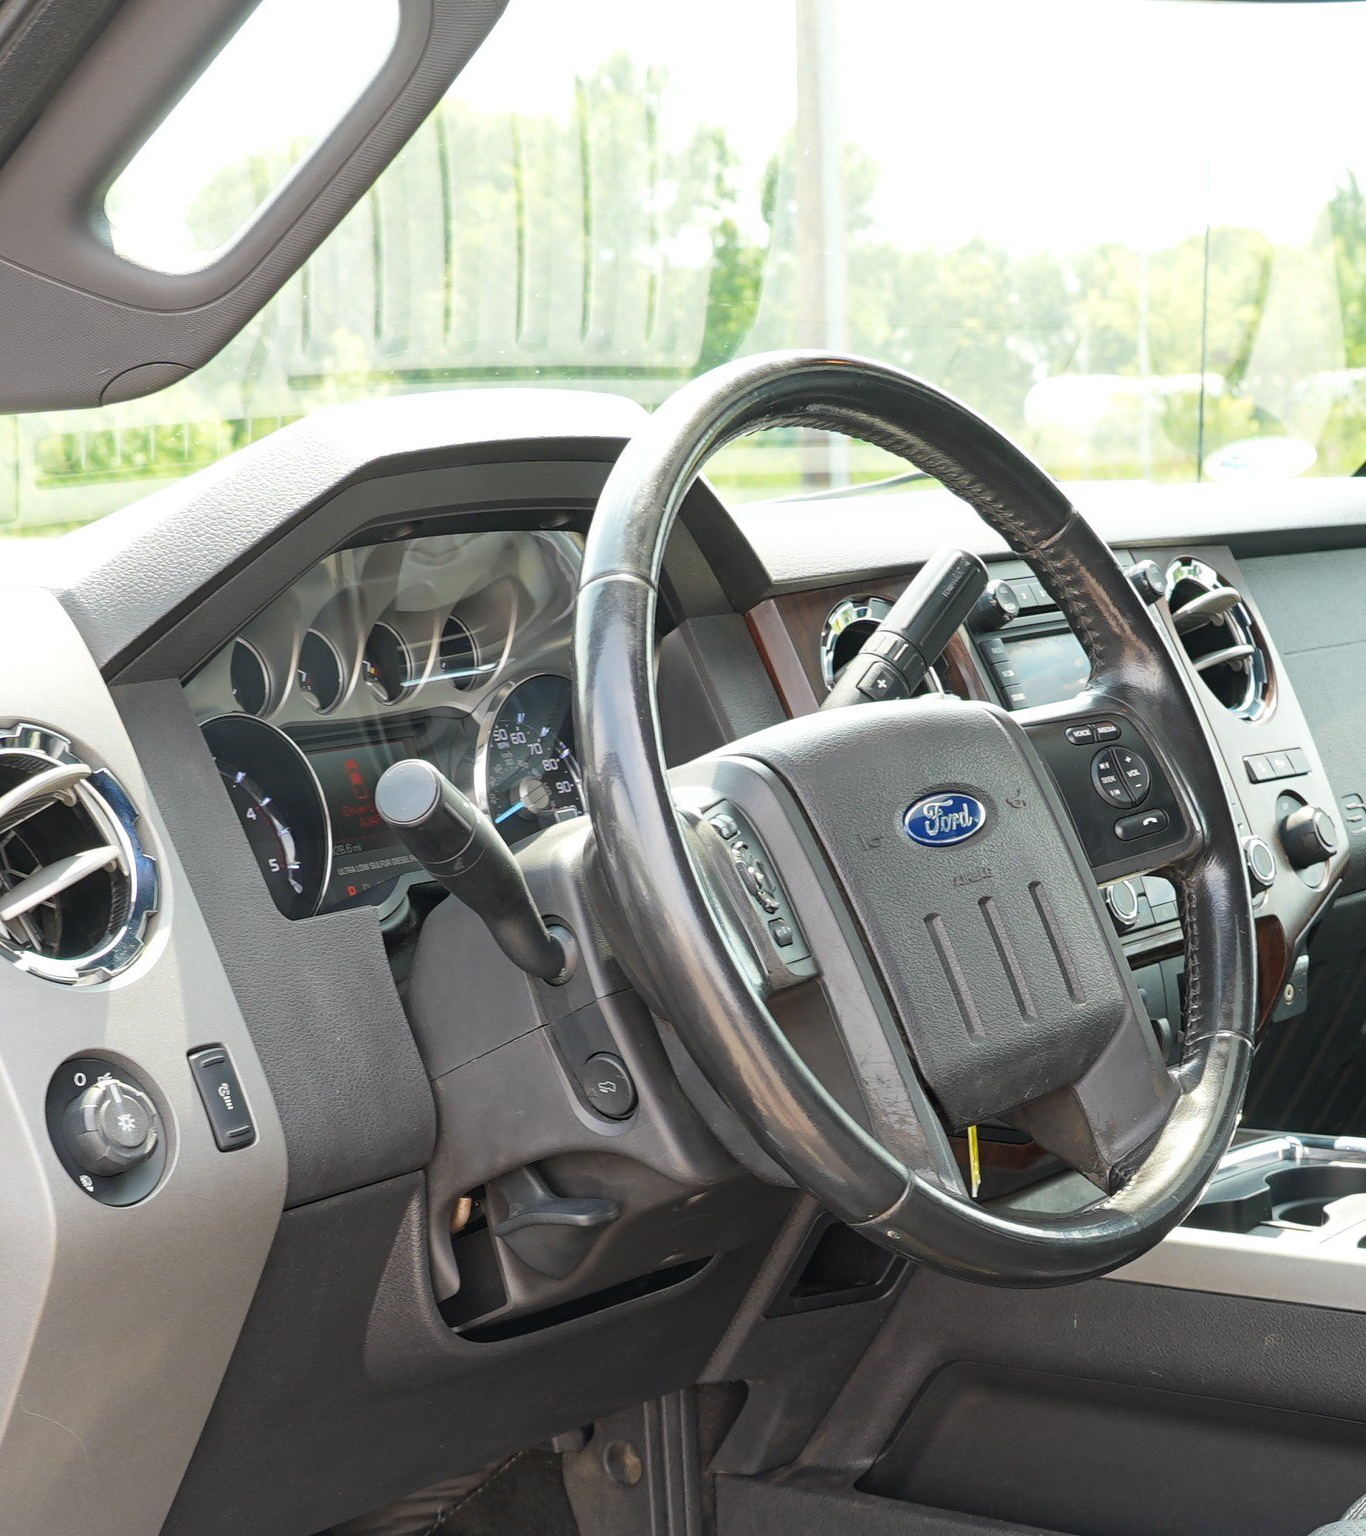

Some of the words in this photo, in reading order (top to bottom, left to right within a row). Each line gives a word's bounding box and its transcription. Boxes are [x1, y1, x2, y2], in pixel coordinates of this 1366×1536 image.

[493, 728, 509, 741] 50
[509, 731, 527, 745] 60
[526, 742, 544, 756] 70
[541, 758, 559, 772] 80
[1126, 768, 1142, 778] VOL
[556, 781, 573, 794] 90
[246, 807, 257, 821] 4
[921, 799, 975, 836] Ford
[268, 858, 280, 873] 5
